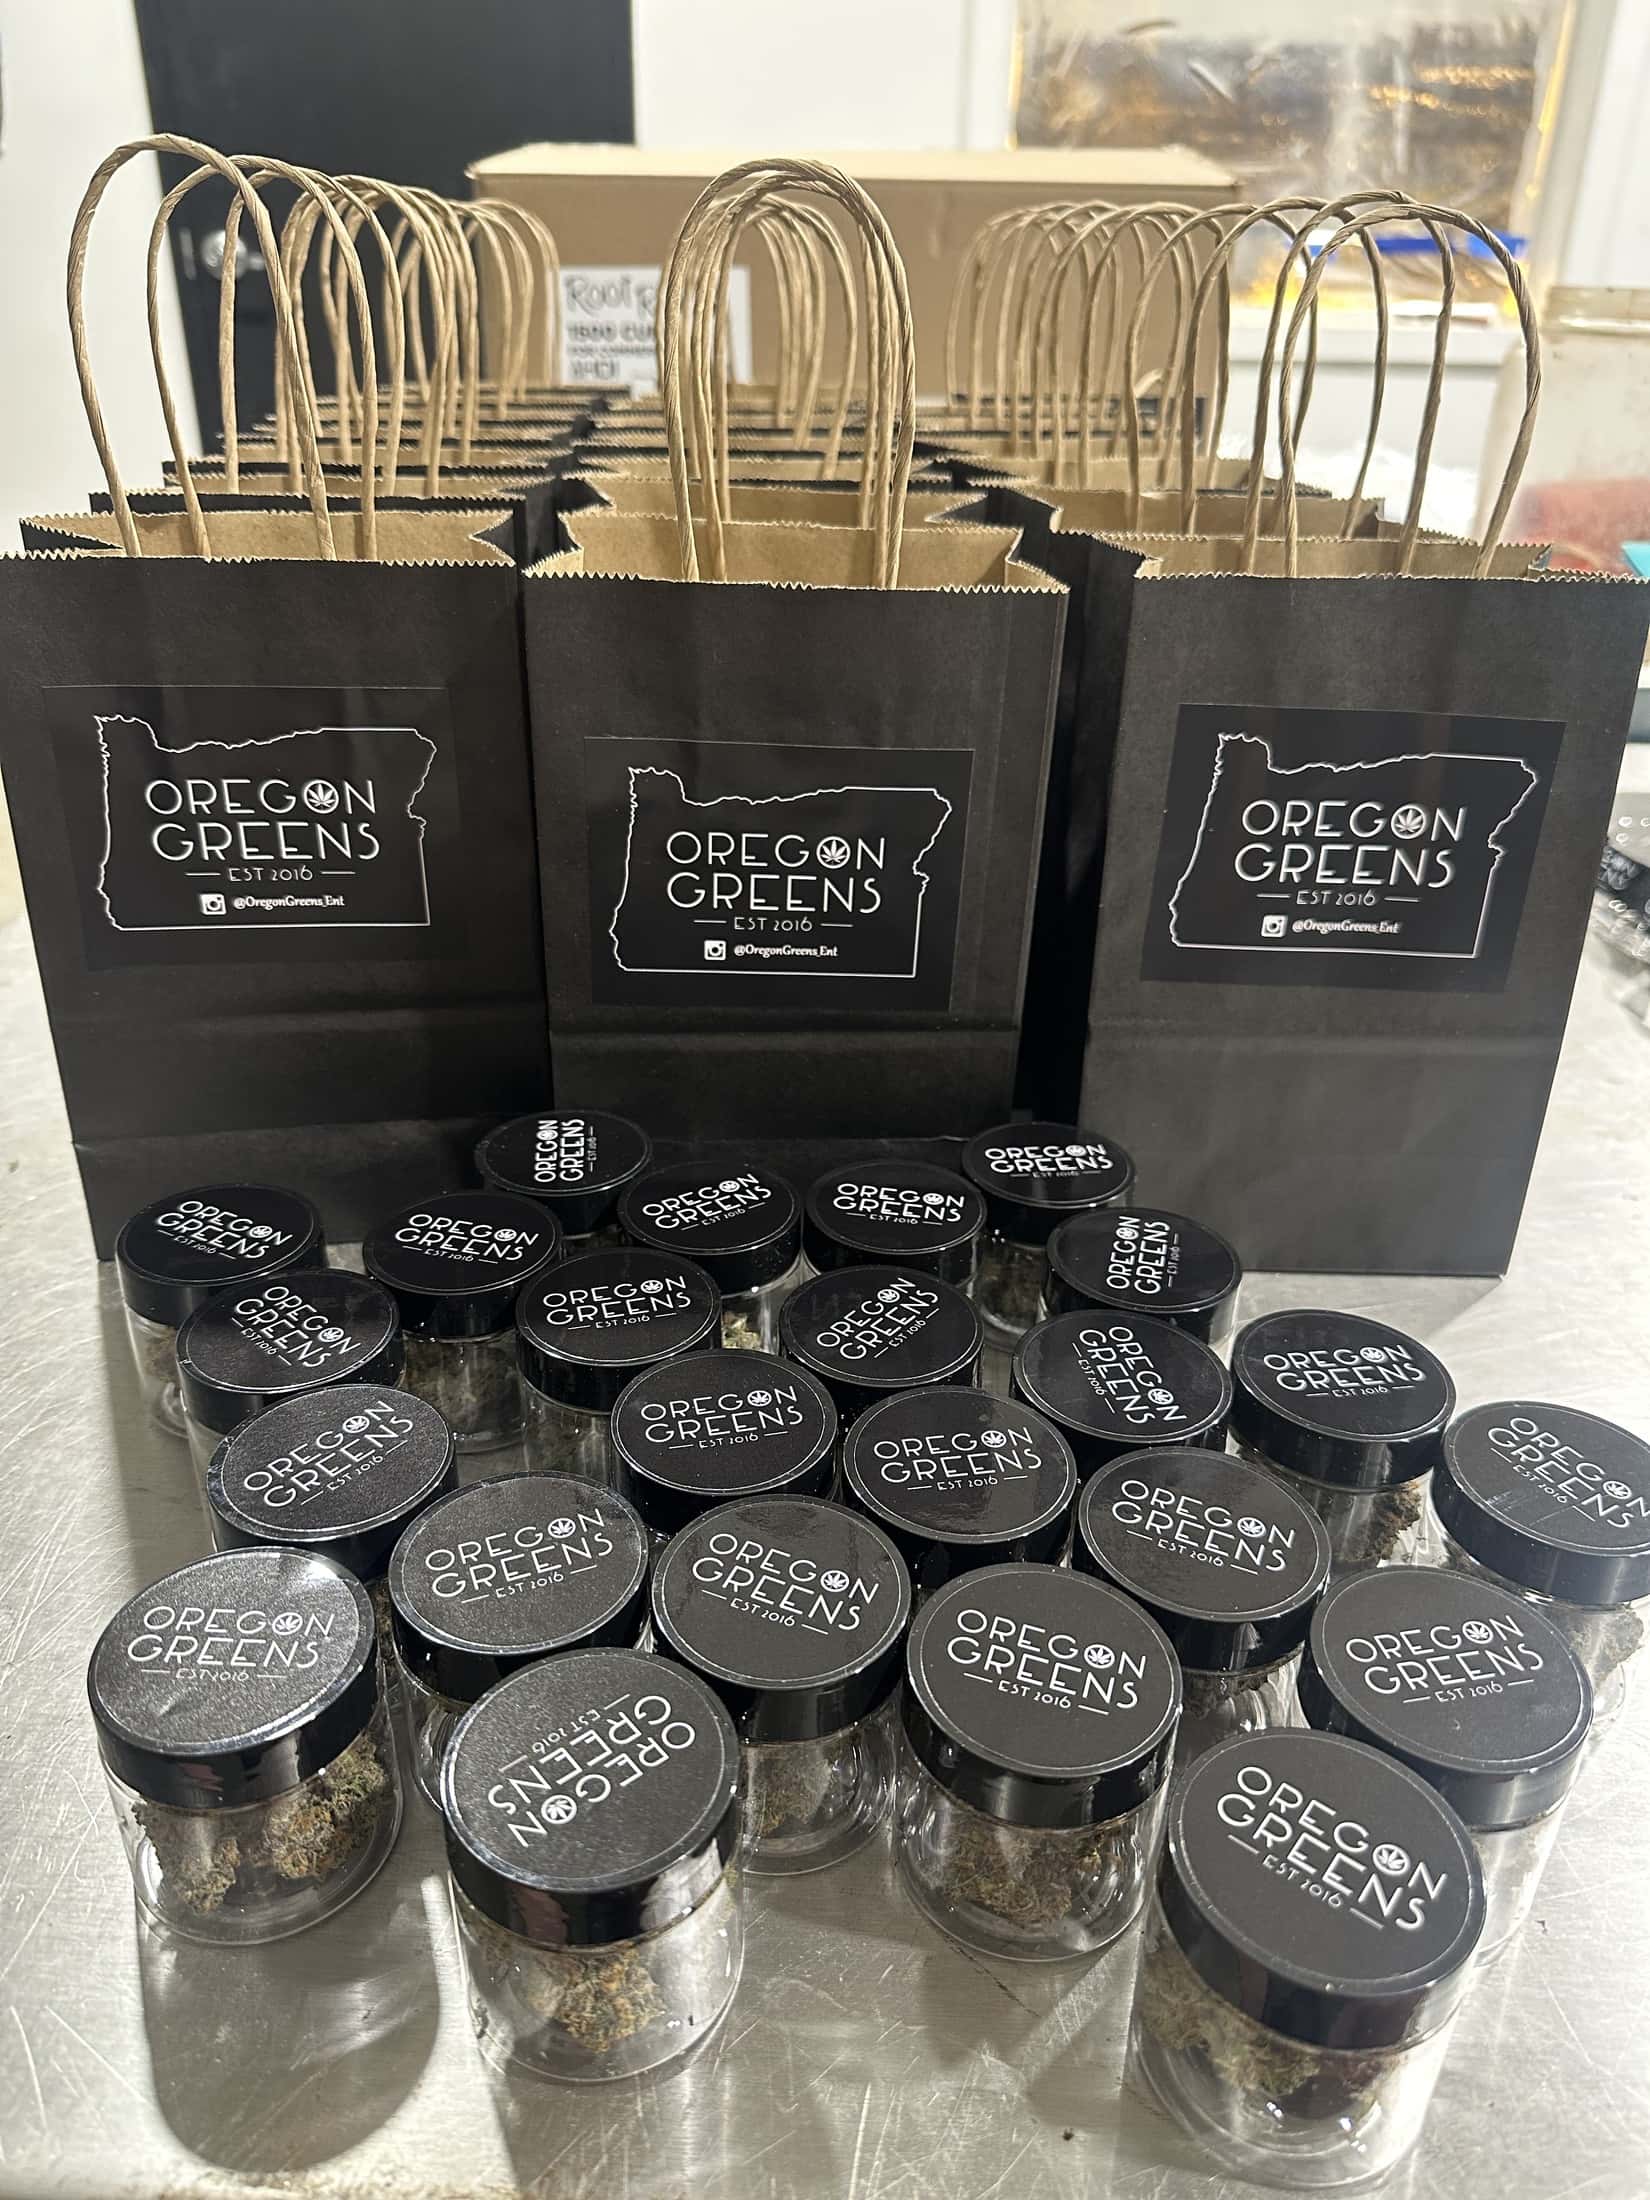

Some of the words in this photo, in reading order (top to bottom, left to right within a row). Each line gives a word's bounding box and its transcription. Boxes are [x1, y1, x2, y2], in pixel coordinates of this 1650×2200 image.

[146, 779, 375, 814] OREGON
[1242, 800, 1467, 841] OREGON
[152, 822, 379, 861] GREENS
[667, 831, 885, 870] OREGON
[229, 868, 263, 881] EST
[272, 866, 313, 881] 2016
[1235, 844, 1454, 888] GREENS
[667, 872, 881, 913] GREENS
[1296, 891, 1330, 904] EST
[1336, 891, 1375, 906] 2016
[734, 917, 768, 930] EST
[774, 917, 812, 931] 2016
[534, 1120, 558, 1182] OREGON
[560, 1119, 584, 1181] GREENS
[985, 1144, 1107, 1160] OREGON
[990, 1156, 1113, 1173] GREENS
[642, 1173, 760, 1217] OREGON
[655, 1185, 772, 1229] GREENS
[833, 1196, 961, 1222] GREENS
[837, 1183, 964, 1208] OREGON
[156, 1213, 269, 1259] GREENS
[179, 1200, 292, 1245] OREGON
[409, 1214, 539, 1246] OREGON
[702, 1216, 723, 1226] EST
[724, 1208, 746, 1220] 2016
[174, 1236, 196, 1247] EST
[395, 1228, 523, 1261] GREENS
[424, 1249, 447, 1257] EST
[1106, 1216, 1140, 1289] OREGON
[1134, 1222, 1170, 1294] GREENS
[1167, 1262, 1178, 1274] EST
[543, 1276, 687, 1308] OREGON
[546, 1292, 690, 1325] GREENS
[264, 1286, 361, 1355] OREGON
[596, 1317, 618, 1328] EST
[623, 1314, 650, 1325] 2016
[817, 1277, 915, 1347] OREGON
[840, 1290, 938, 1360] GREENS
[234, 1298, 331, 1368] GREENS
[240, 1328, 260, 1345] EST
[889, 1335, 907, 1347] EST
[907, 1320, 926, 1335] 2016
[1079, 1329, 1156, 1424] GREENS
[1108, 1326, 1187, 1420] OREGON
[1263, 1344, 1414, 1371] OREGON
[1078, 1359, 1095, 1376] EST
[1088, 1378, 1108, 1395] 2016
[1276, 1362, 1426, 1392] GREENS
[1331, 1388, 1355, 1397] EST
[1361, 1386, 1388, 1396] 2016
[641, 1386, 797, 1420] OREGON
[645, 1406, 803, 1443] GREENS
[699, 1438, 723, 1449] EST
[729, 1433, 759, 1444] 2016
[874, 1427, 1033, 1459] OREGON
[244, 1401, 394, 1491] OREGON
[264, 1416, 413, 1507] GREENS
[327, 1473, 352, 1491] EST
[355, 1455, 383, 1474] 2016
[881, 1449, 1042, 1483] GREENS
[937, 1480, 962, 1491] EST
[968, 1475, 998, 1488] 2016
[1488, 1428, 1634, 1528] GREENS
[1510, 1418, 1650, 1517] OREGON
[1513, 1464, 1541, 1481] EST
[1538, 1484, 1568, 1503] 2016
[1121, 1480, 1295, 1548] OREGON
[425, 1508, 605, 1571] OREGON
[1112, 1501, 1287, 1571] GREENS
[1158, 1538, 1186, 1554] EST
[1190, 1551, 1224, 1567] 2016
[432, 1532, 613, 1597] GREENS
[709, 1533, 879, 1604] OREGON
[495, 1583, 525, 1598] EST
[531, 1572, 564, 1589] 2016
[693, 1557, 861, 1630] GREENS
[144, 1606, 334, 1636] OREGON
[731, 1598, 761, 1614] EST
[761, 1609, 796, 1627] 2016
[127, 1634, 319, 1668] GREENS
[957, 1609, 1146, 1679] OREGON
[1346, 1615, 1524, 1663] OREGON
[948, 1637, 1137, 1709] GREENS
[1364, 1643, 1543, 1694] GREENS
[998, 1680, 1030, 1696] EST
[1033, 1692, 1071, 1708] 2016
[1435, 1689, 1465, 1703] EST
[1470, 1681, 1503, 1698] 2016
[570, 1709, 601, 1733] EST
[488, 1696, 671, 1815] GREENS
[533, 1727, 568, 1754] 2016
[507, 1722, 695, 1848] OREGON
[1237, 1766, 1448, 1900] OREGON
[1217, 1793, 1424, 1931] GREENS
[1262, 1854, 1300, 1881] EST
[1300, 1879, 1344, 1908] 2016
